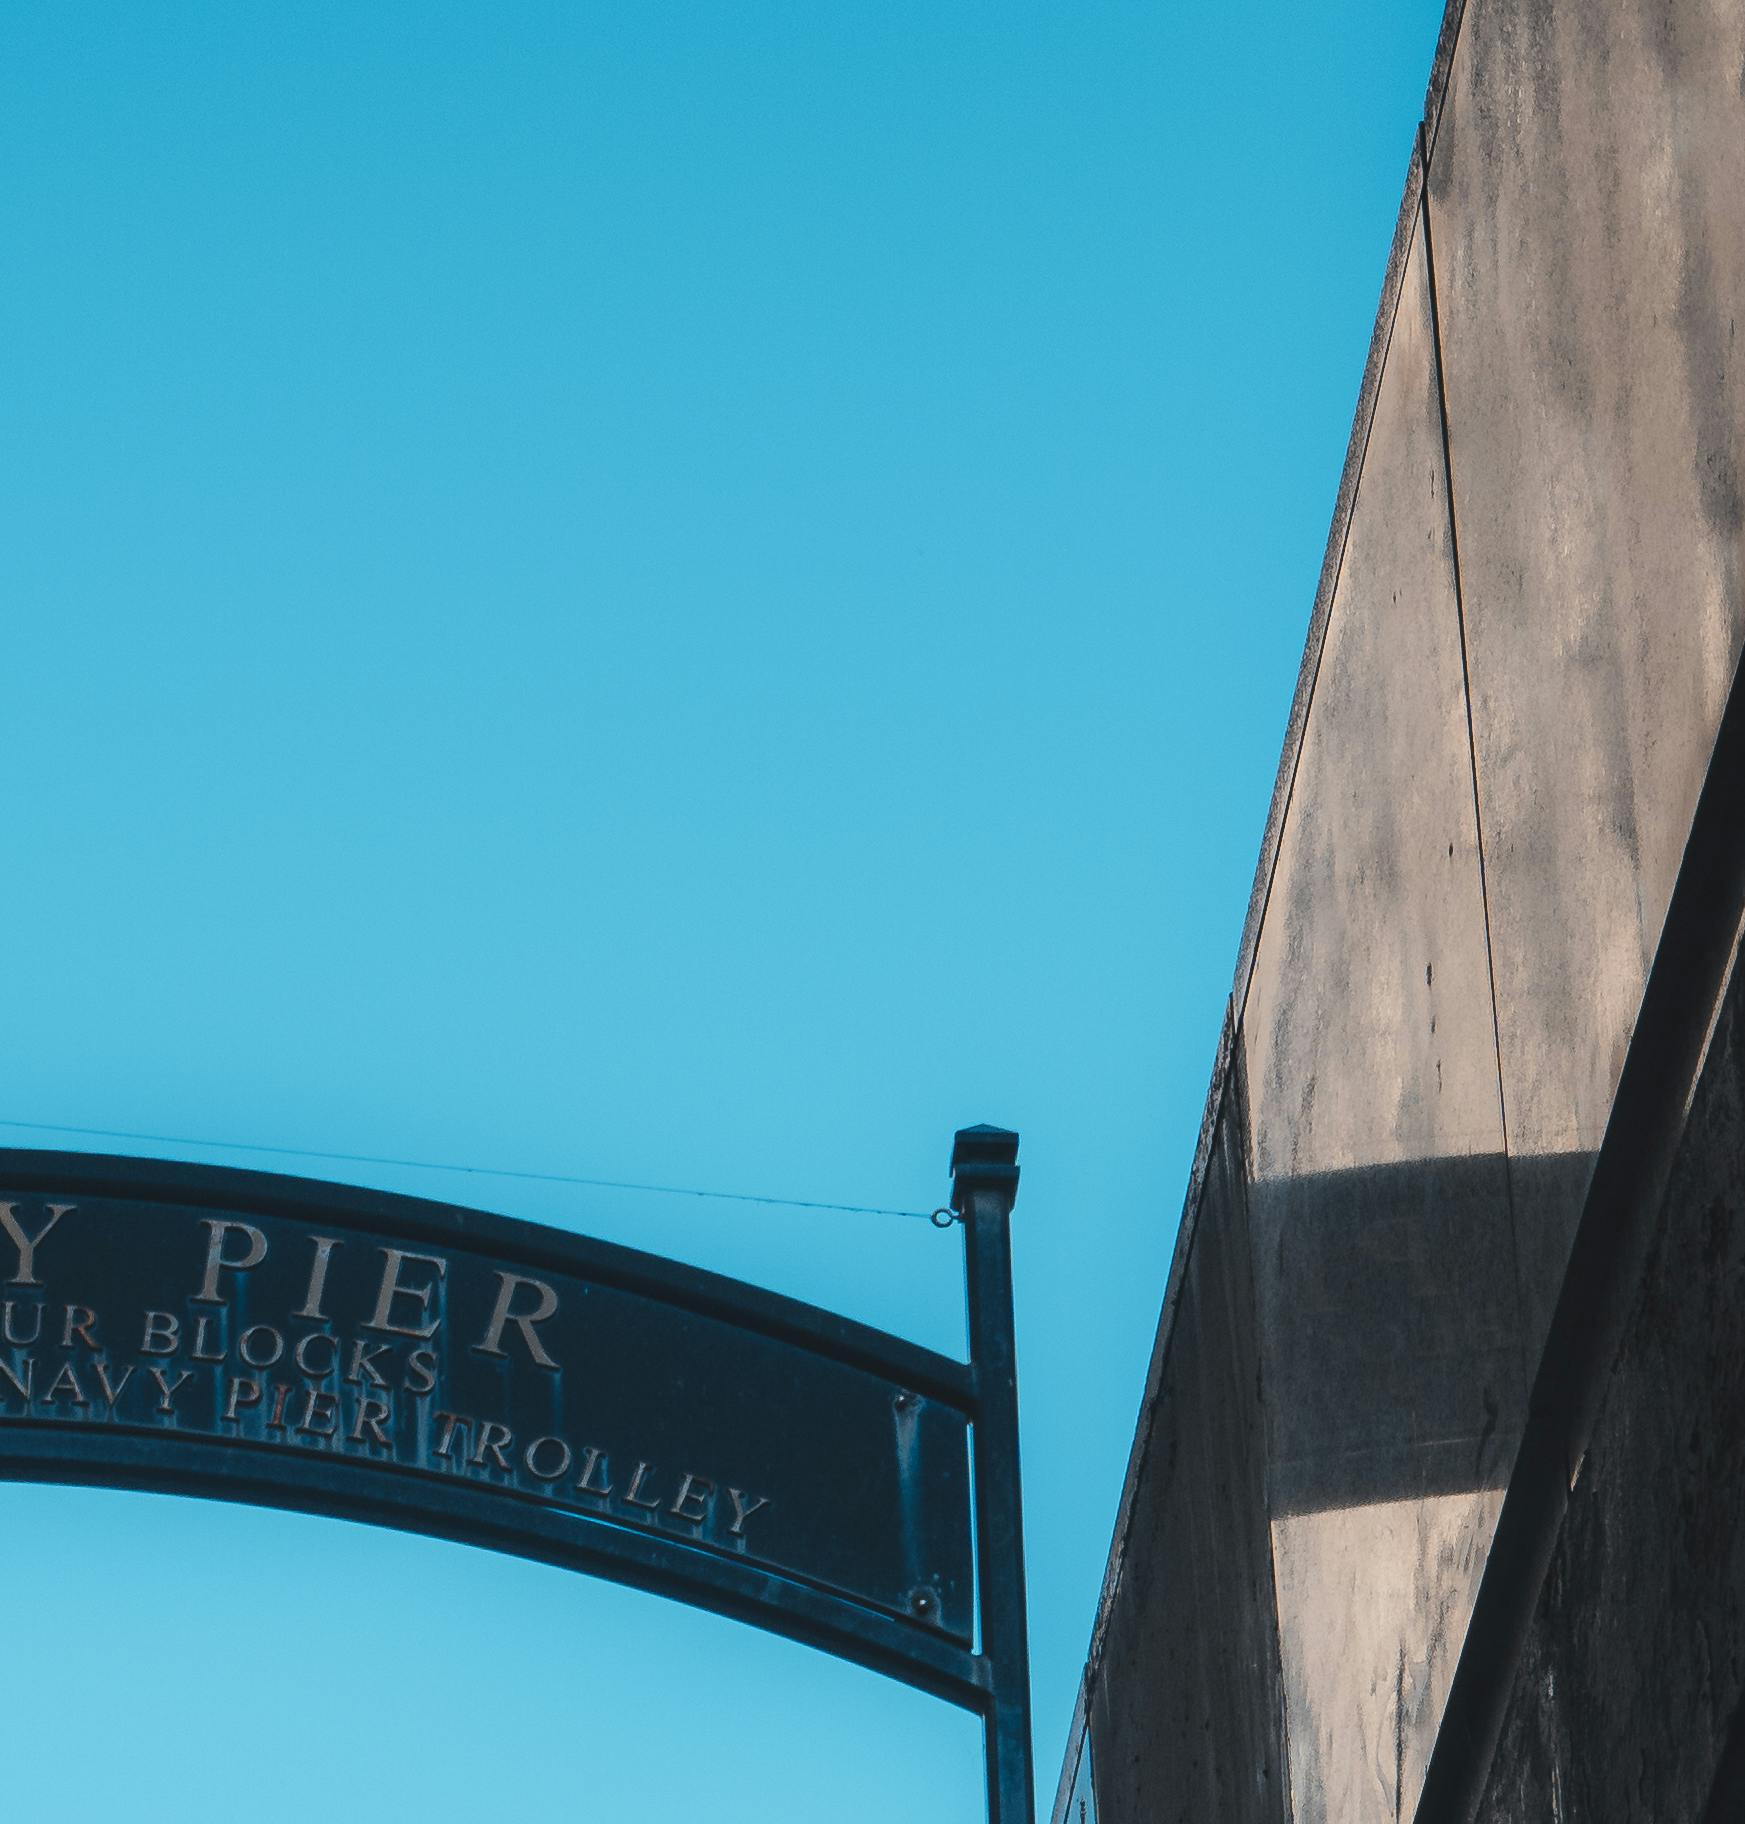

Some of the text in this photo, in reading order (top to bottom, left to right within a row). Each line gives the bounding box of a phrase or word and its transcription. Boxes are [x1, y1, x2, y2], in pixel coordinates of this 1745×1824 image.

[140, 1311, 439, 1395] BLOCKS
[192, 1219, 560, 1369] PIER
[221, 1377, 392, 1449] PIER
[432, 1413, 770, 1538] TROLLEY
